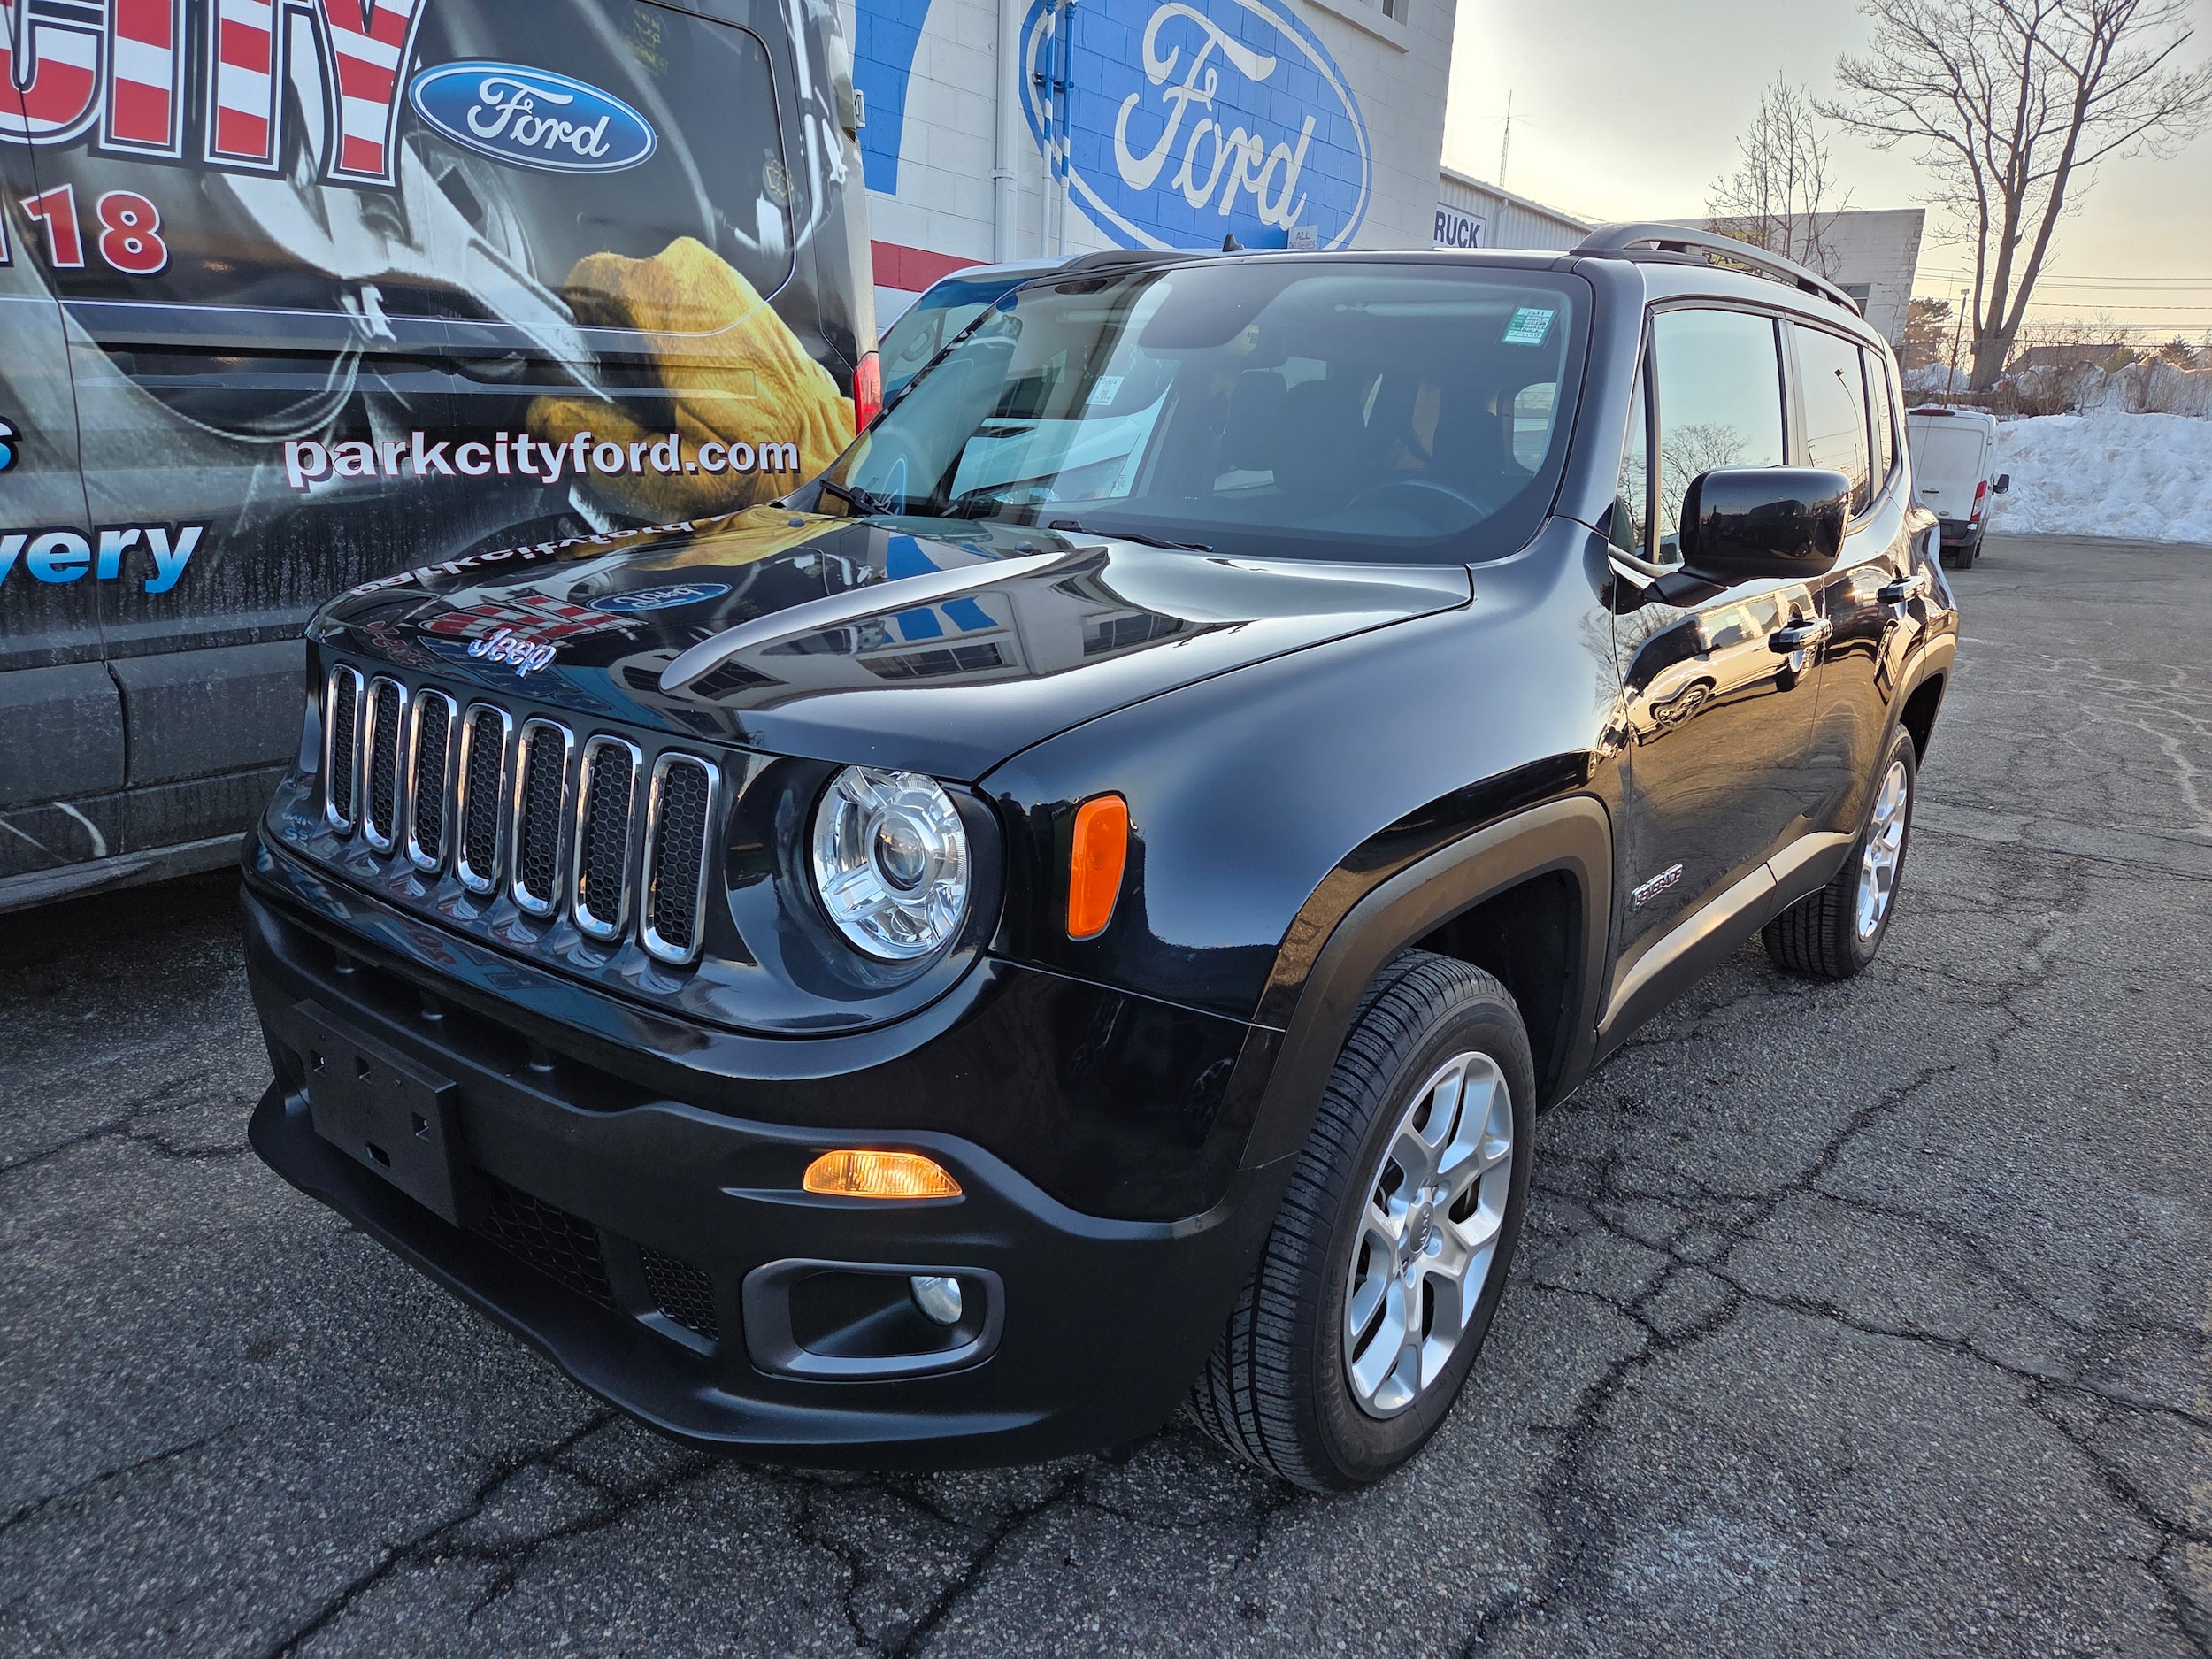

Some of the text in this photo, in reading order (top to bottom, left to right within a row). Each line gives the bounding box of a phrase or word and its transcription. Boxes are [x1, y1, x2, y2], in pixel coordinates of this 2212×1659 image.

[467, 76, 611, 158] Ford
[1114, 2, 1317, 231] Ford
[0, 183, 168, 274] 18
[1295, 231, 1310, 240] ALL
[284, 430, 800, 488] parkcityford.com
[467, 627, 557, 678] Jeep
